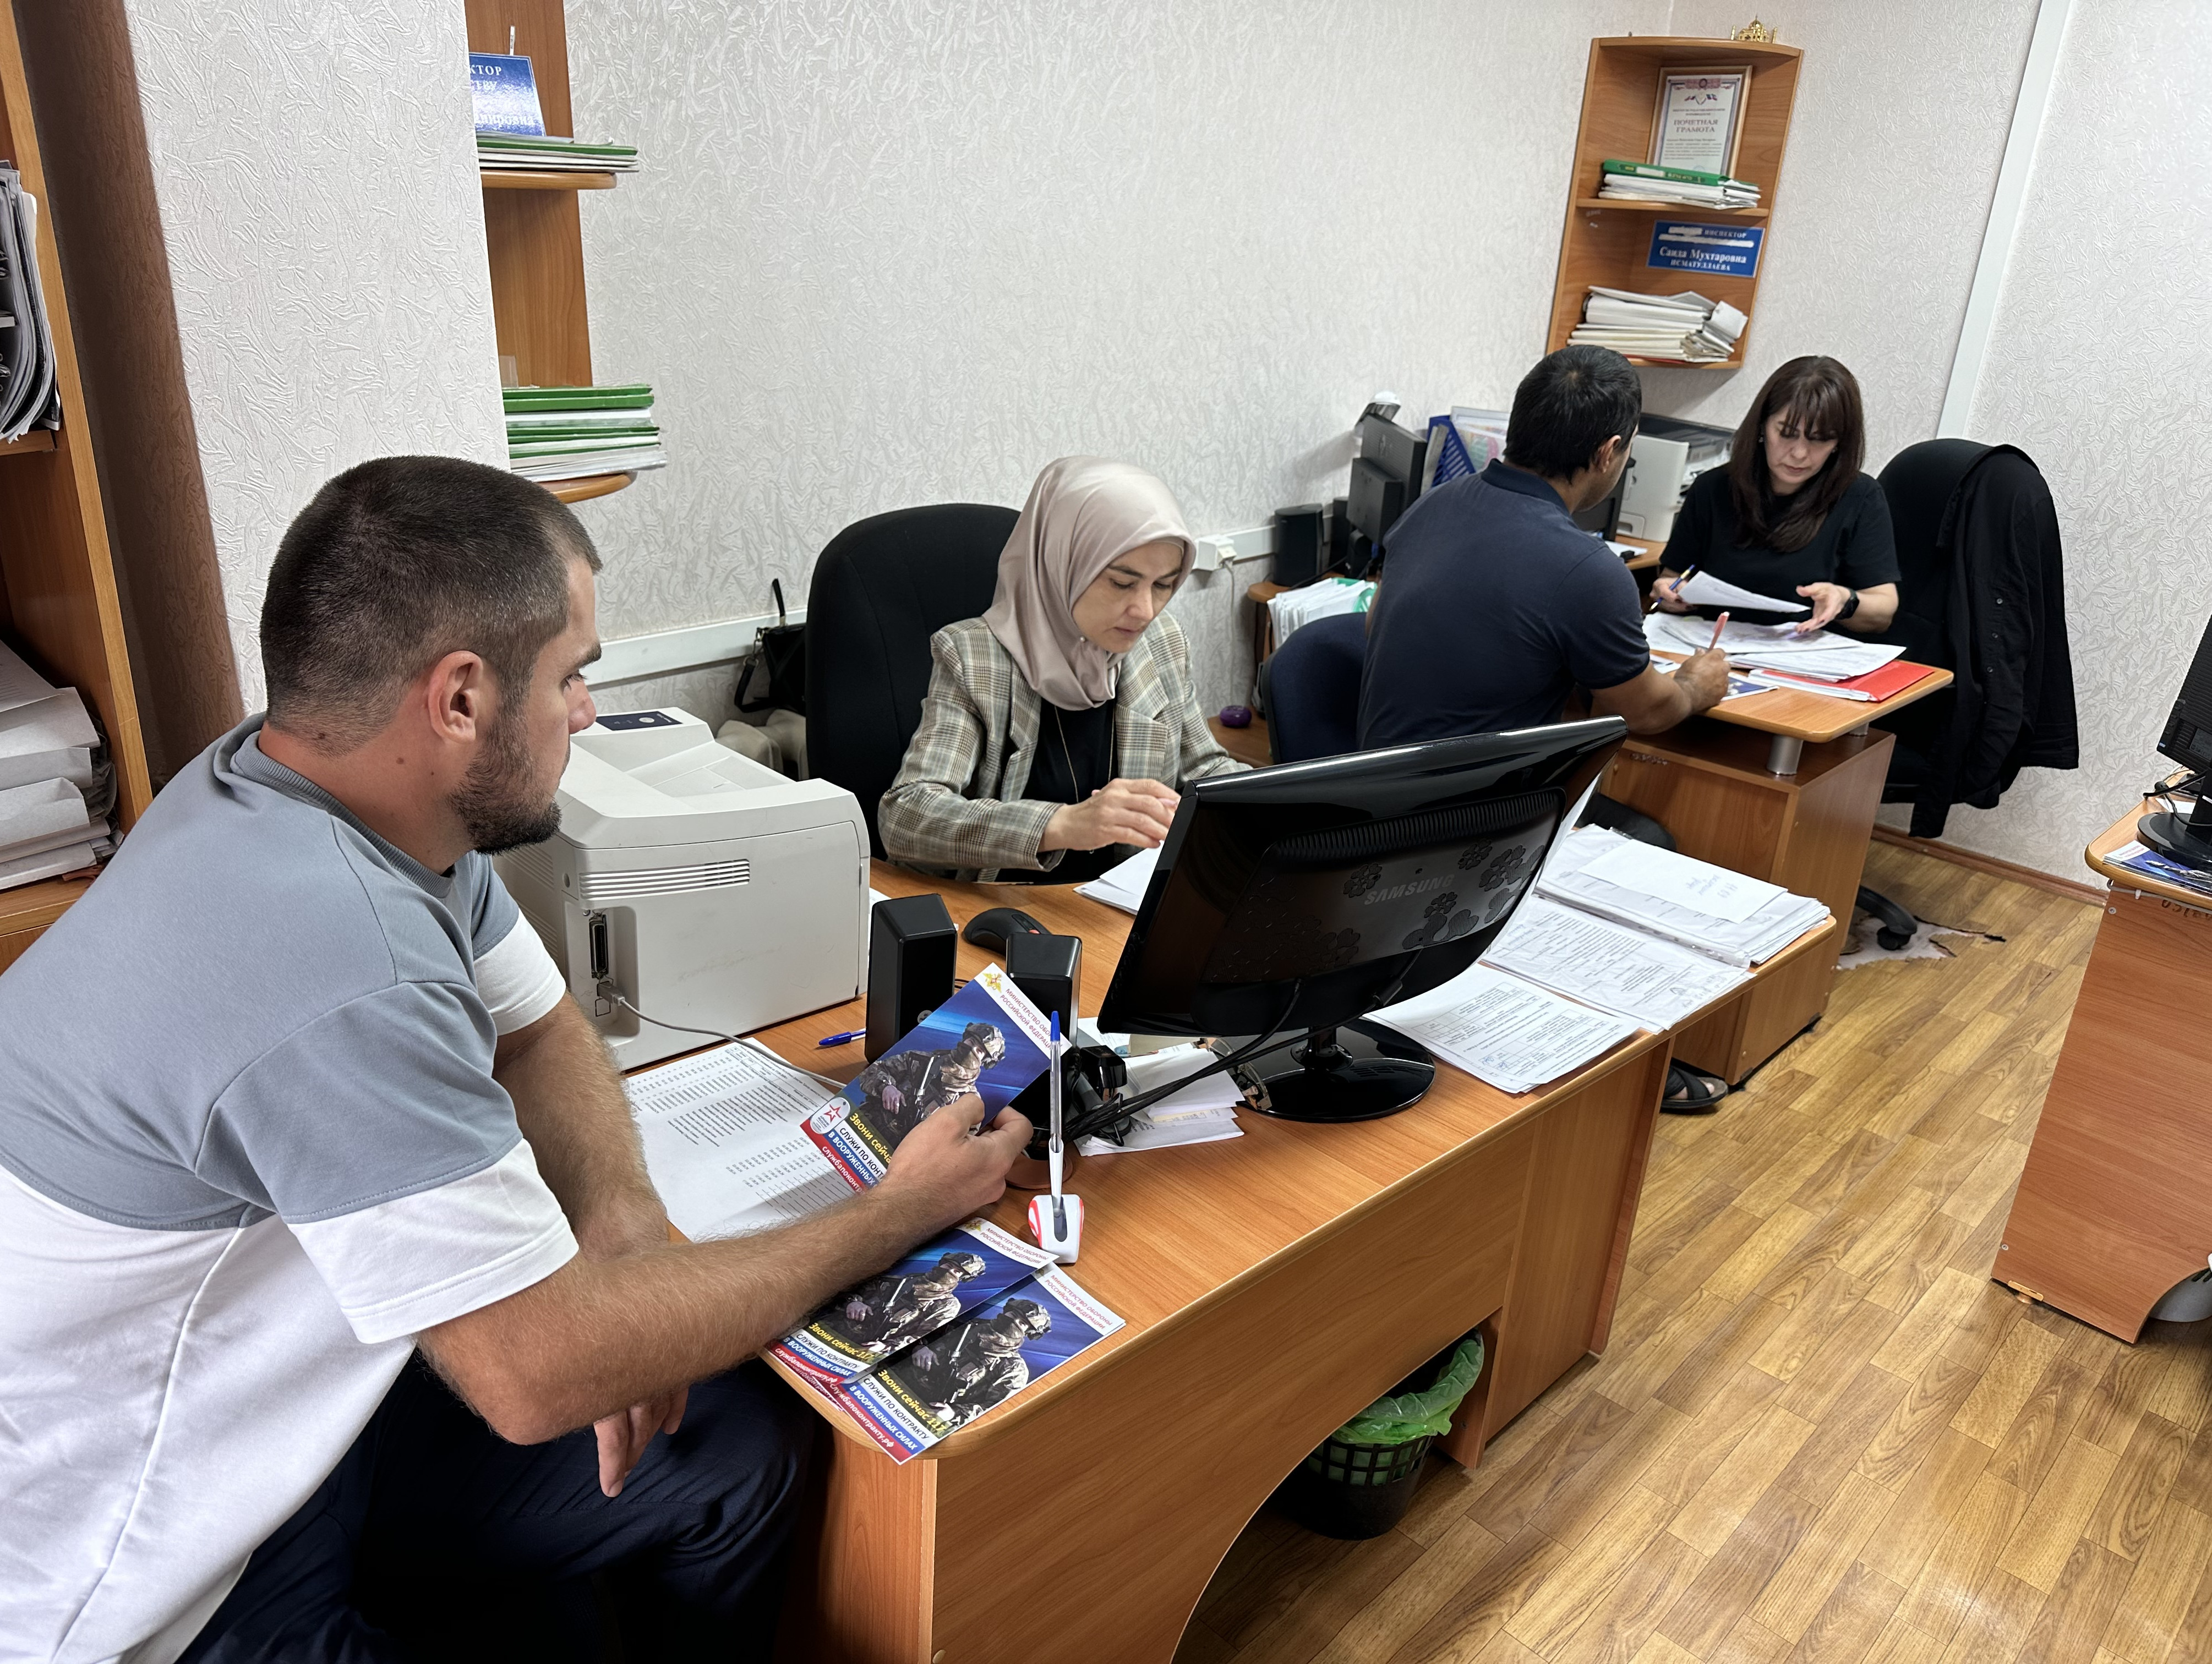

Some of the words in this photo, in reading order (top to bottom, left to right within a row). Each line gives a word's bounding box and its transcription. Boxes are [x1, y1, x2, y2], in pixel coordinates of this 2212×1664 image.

[469, 64, 502, 75] КТОР
[1659, 246, 1687, 258] Саида
[1689, 249, 1747, 264] Мухтаровна
[1364, 874, 1455, 905] SAMSUNG
[1000, 994, 1030, 1026] РОССИЙСКОЙ
[1029, 1025, 1053, 1050] ФЕДЕРАЦИ
[1006, 988, 1040, 1025] МИНИСТЕРСТВО
[839, 1127, 860, 1151] СЛУЖИ
[859, 1150, 869, 1161] ПО
[850, 1113, 873, 1140] Звони
[871, 1139, 893, 1164] сейча
[832, 1137, 876, 1185] ВООРУЖЕННЫХ
[980, 1232, 1013, 1256] РОССИЙСКОЙ
[1012, 1251, 1042, 1264] ФЕДЕРАЦИИ
[986, 1228, 1024, 1251] МИНИСТЕРСТВО
[1023, 1247, 1049, 1261] ОБОРОНЫ
[1046, 1279, 1077, 1307] РОССИЙСКОЙ
[1075, 1305, 1106, 1329] ФЕДЕРАЦИИ
[1051, 1275, 1088, 1307] МИНИСТЕРСТВО
[1086, 1305, 1112, 1326] ОБОРОНЫ
[796, 1334, 818, 1350] СЛУЖИ
[825, 1353, 860, 1369] КОНТРАКТУ
[809, 1323, 833, 1342] Звони
[832, 1338, 858, 1355] сейчас
[788, 1340, 833, 1371] ВООРУЖЕННЫХ
[830, 1366, 853, 1377] СИЛАХ
[829, 1383, 895, 1448] службапоконтракту.рф
[864, 1378, 886, 1399] СЛУЖИ
[883, 1398, 895, 1409] ПО
[893, 1408, 930, 1439] КОНТРАКТУ
[878, 1369, 903, 1395] Звони
[901, 1393, 928, 1420] сейчас
[926, 1416, 947, 1432] 117
[853, 1390, 898, 1432] ВООРУЖЕННЫХ
[895, 1428, 918, 1450] СИЛАХ
